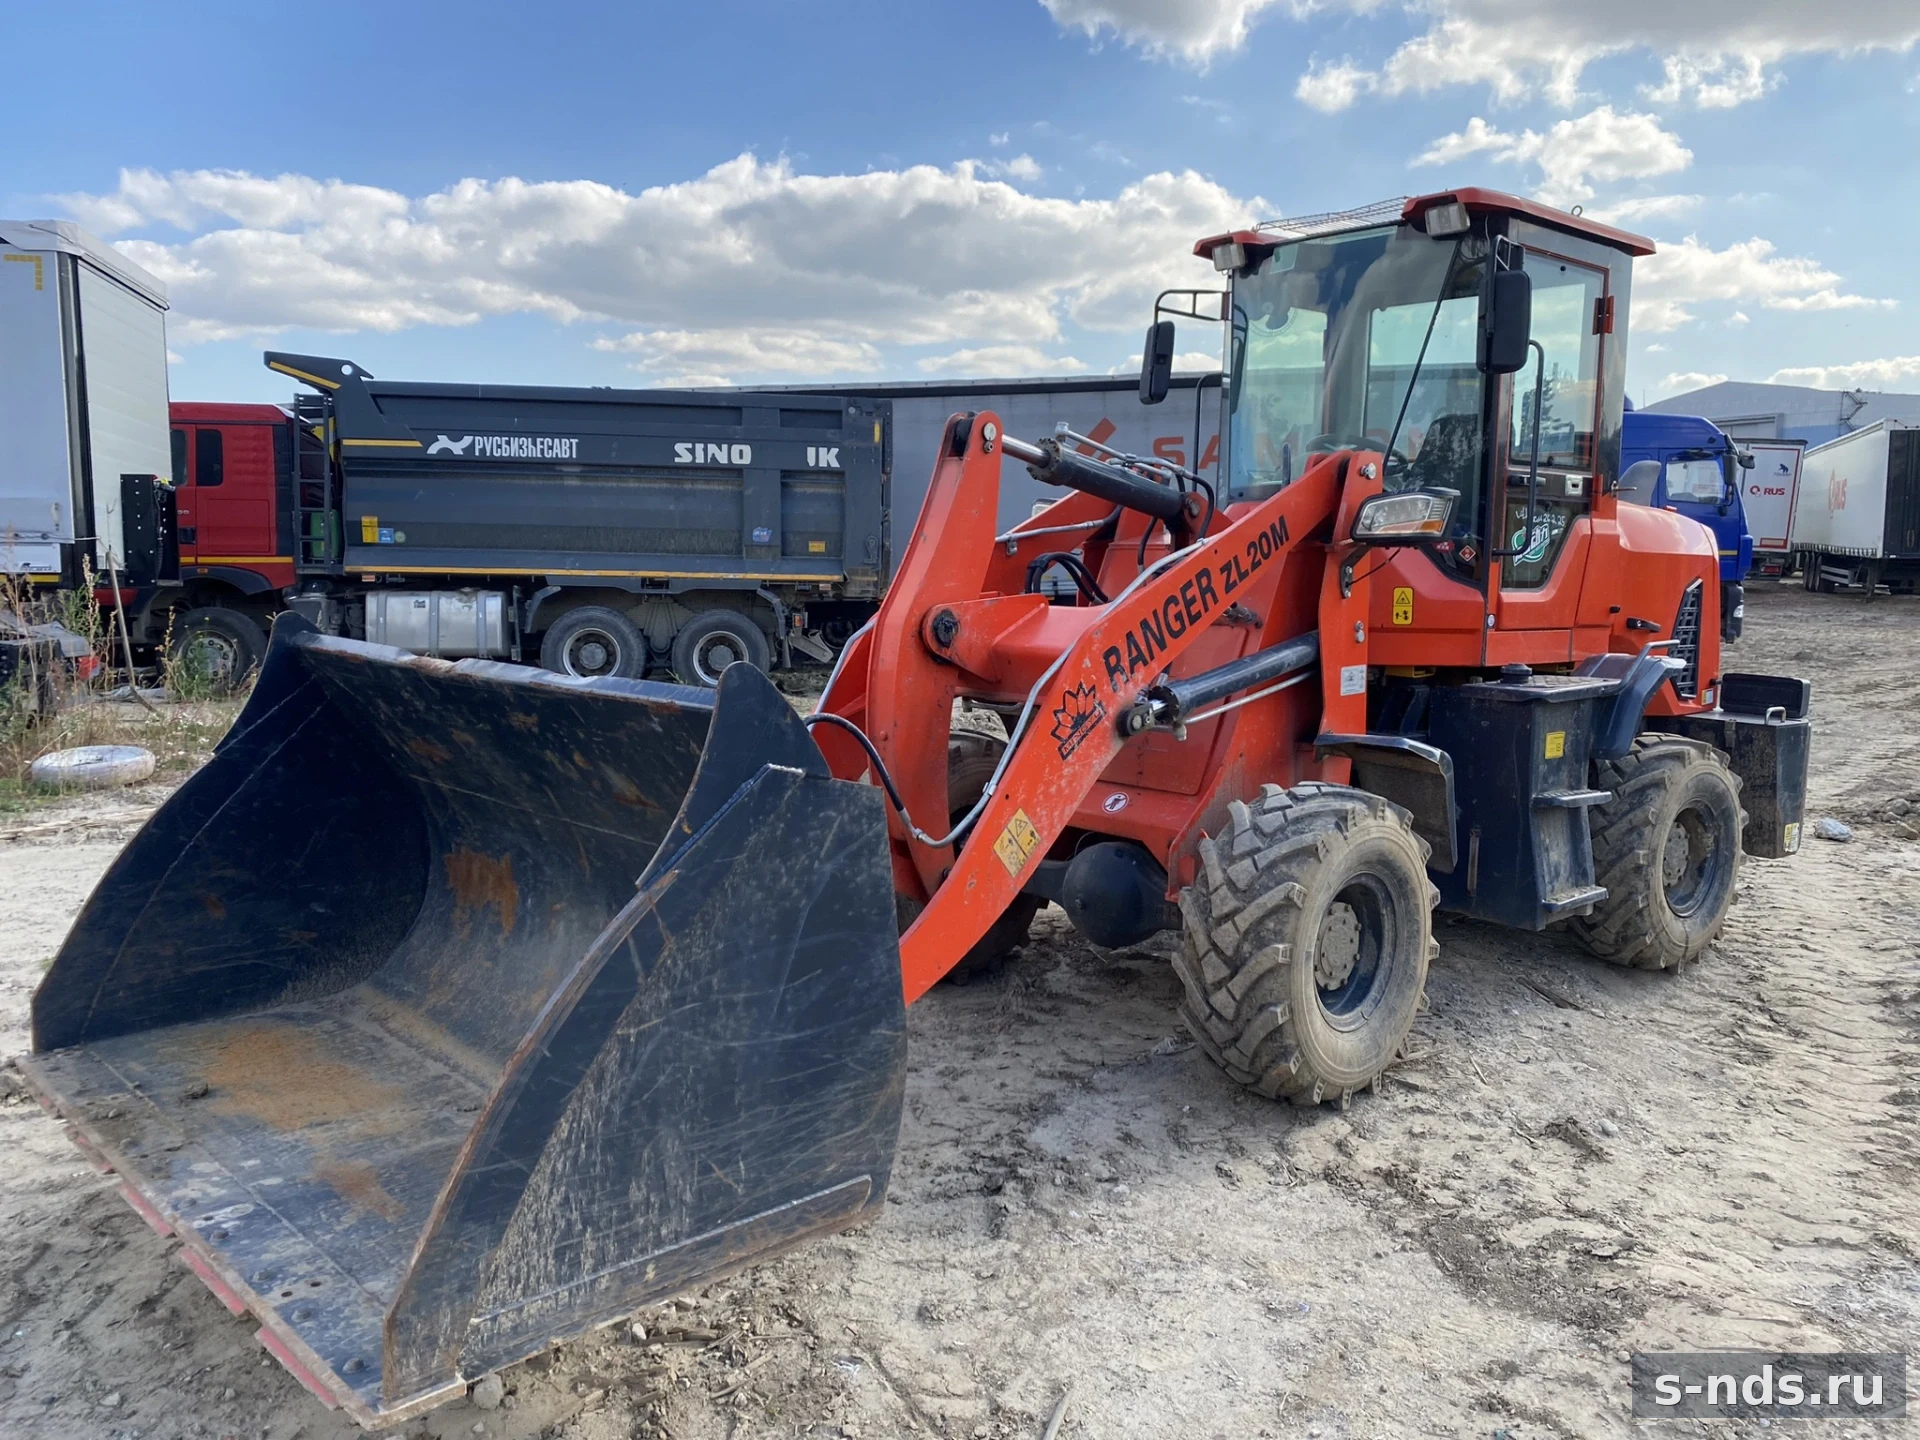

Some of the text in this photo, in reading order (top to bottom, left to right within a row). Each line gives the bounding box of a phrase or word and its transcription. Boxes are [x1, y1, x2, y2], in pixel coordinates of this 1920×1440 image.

[1763, 487, 1786, 496] RUS
[1102, 514, 1290, 693] RANGER ZL20M
